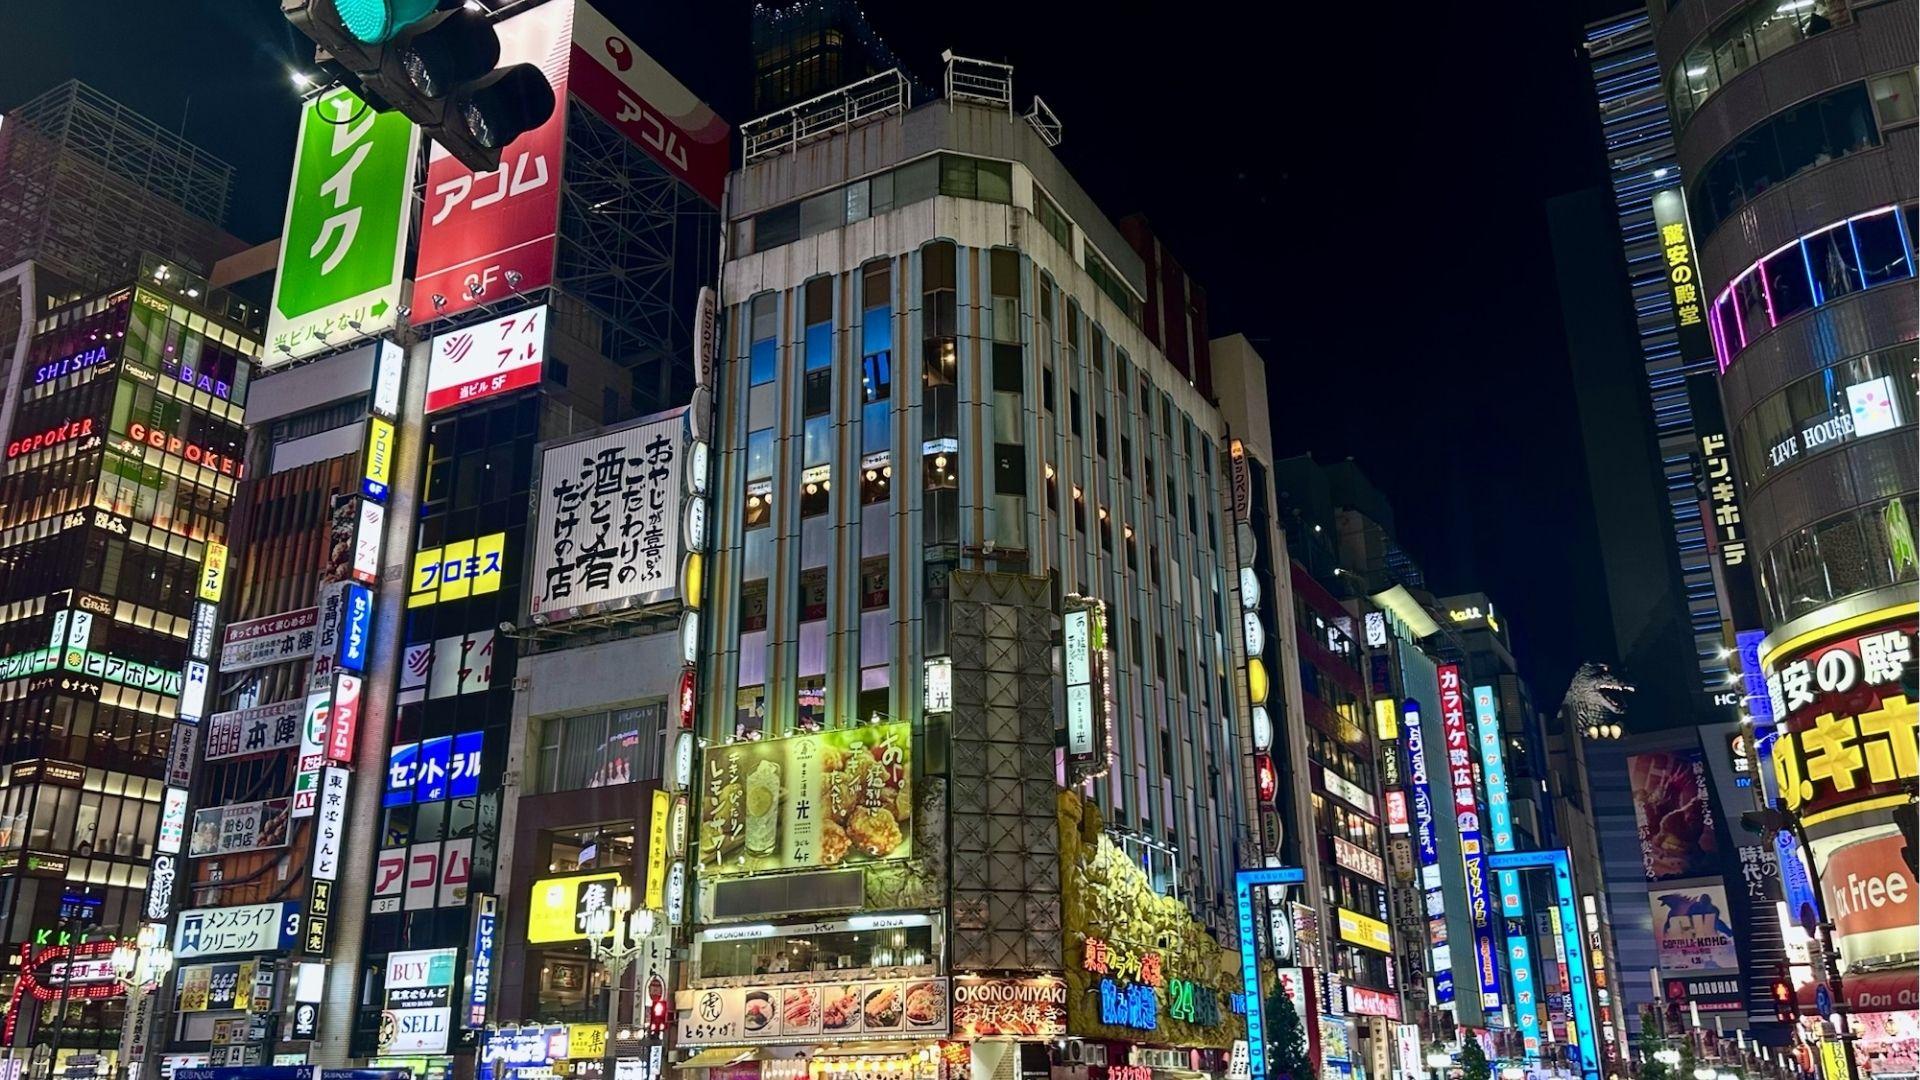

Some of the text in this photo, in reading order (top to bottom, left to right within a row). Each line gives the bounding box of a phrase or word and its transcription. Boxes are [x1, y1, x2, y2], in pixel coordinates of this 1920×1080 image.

[616, 90, 688, 172] アコム
[432, 151, 549, 227] アコム
[463, 265, 500, 302] 3F
[1661, 223, 1701, 327] 驚安の殿堂
[35, 346, 107, 384] SHISHA
[181, 366, 229, 399] BAR
[459, 375, 507, 400] 当ビル 5F
[8, 418, 92, 459] GGPOKER
[373, 427, 390, 478] プロミス
[1771, 413, 1854, 467] LIVE HOUSE
[617, 456, 645, 584] こだわりの
[640, 434, 673, 582] おやじが喜ぶ
[542, 479, 583, 602] だけの店
[421, 551, 502, 588] プロミス
[280, 631, 315, 655] 本陣
[347, 596, 367, 660] セントラル
[245, 715, 297, 750] 本陣
[333, 706, 352, 748] アコム
[1440, 671, 1475, 805] カラオケ歌広場
[389, 750, 482, 789] セントラル
[428, 788, 442, 799] 4F
[796, 799, 810, 821] 光
[318, 774, 343, 873] 東京ぶらんど
[709, 759, 726, 866] レモンサワー
[376, 850, 471, 893] アコム
[793, 847, 809, 863] 4F
[313, 884, 327, 912] 買取
[379, 899, 395, 912] 3F
[1467, 857, 1488, 928] マツモトキヨシ
[1847, 871, 1909, 914] Free
[205, 907, 275, 929] メンズライフ
[285, 913, 301, 935] 3
[308, 921, 324, 952] 販売
[713, 930, 763, 940] OKONOMIYAKI
[872, 918, 905, 928] MONJA
[201, 930, 259, 952] クリニック
[392, 961, 428, 982] BUY
[1239, 901, 1261, 1058] GODZILLA ROAD
[1689, 980, 1739, 996] MARUHAN
[954, 985, 1067, 1004] OKONOMIYAKI
[1858, 992, 1893, 1007] Don
[401, 1014, 444, 1034] SELL
[963, 1003, 1059, 1024] お好み焼き
